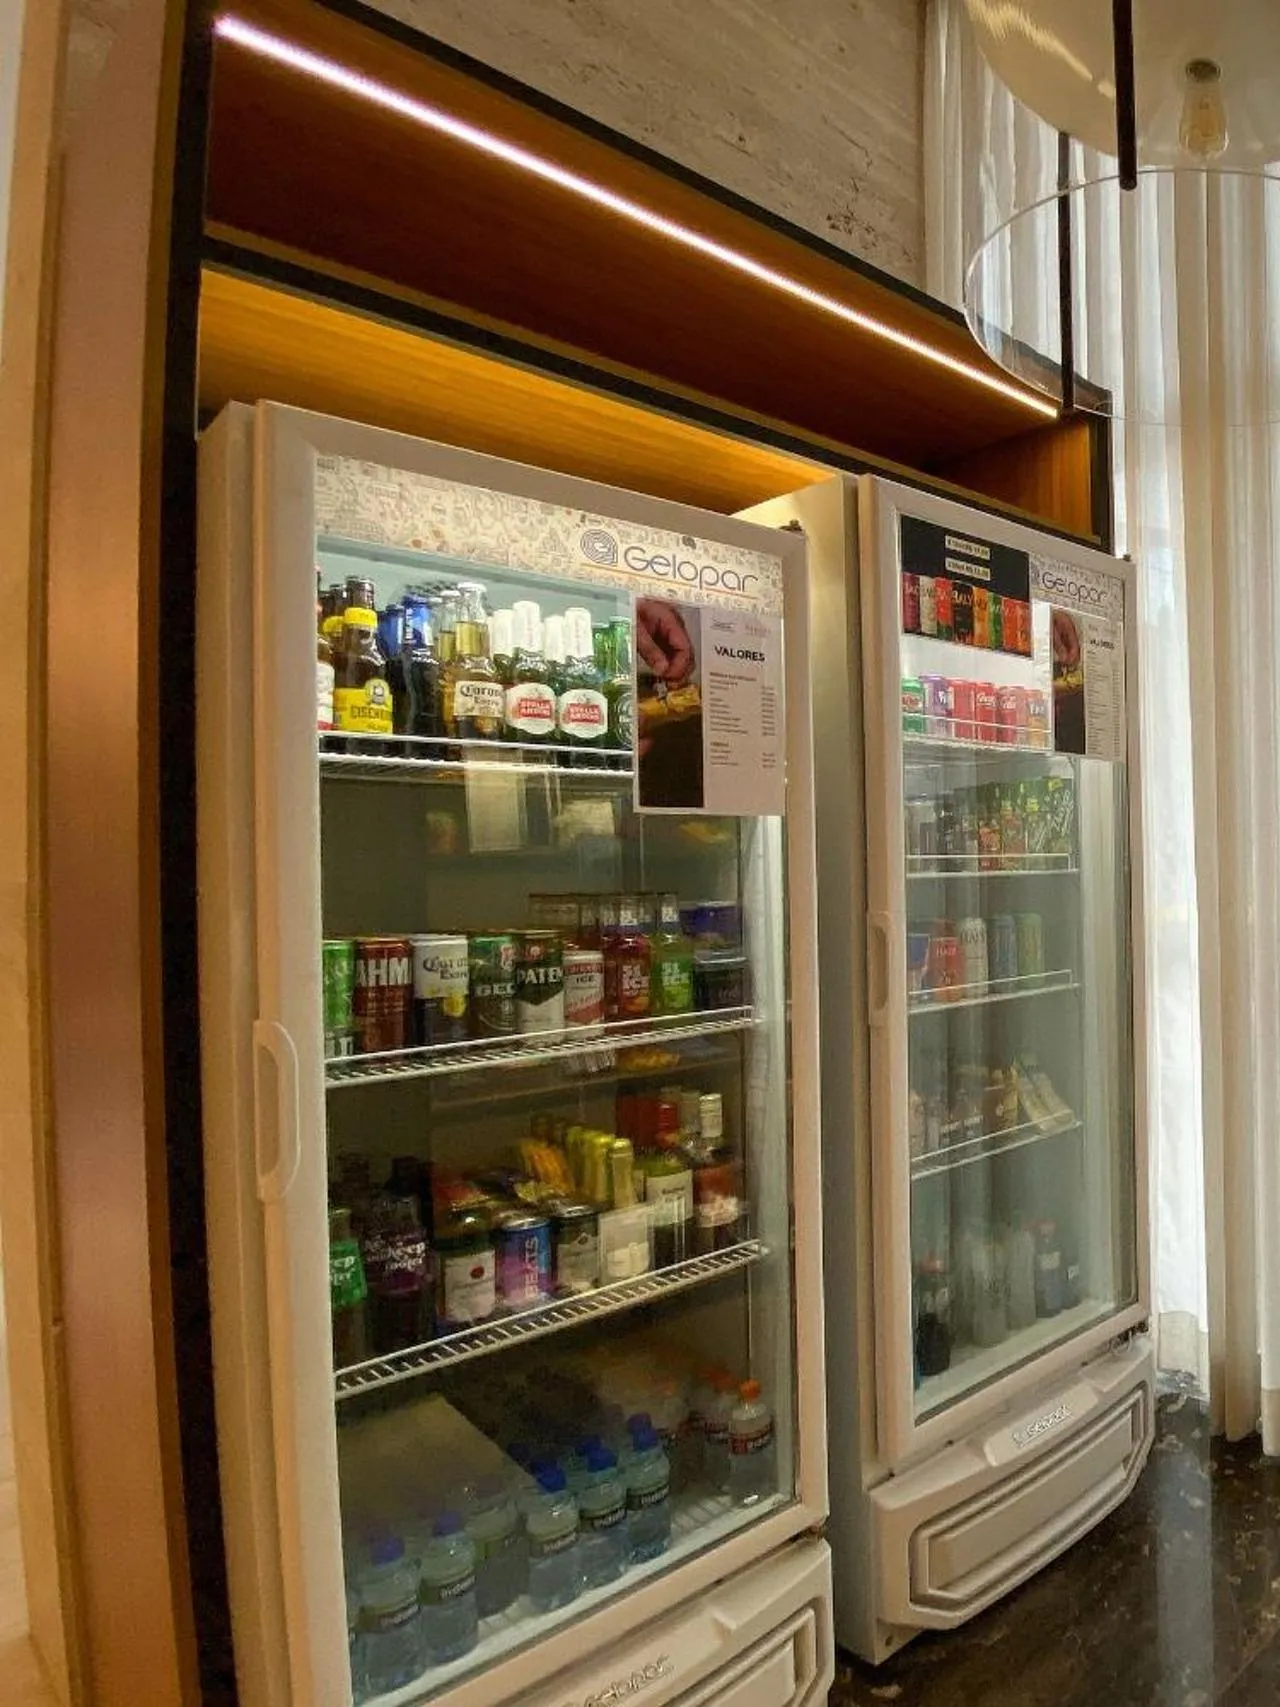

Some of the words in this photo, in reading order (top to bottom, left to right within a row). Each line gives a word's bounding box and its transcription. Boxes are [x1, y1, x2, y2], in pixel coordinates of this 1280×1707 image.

[623, 545, 759, 592] Gelopar
[1042, 571, 1108, 603] Gelopar
[714, 645, 766, 662] VALORES
